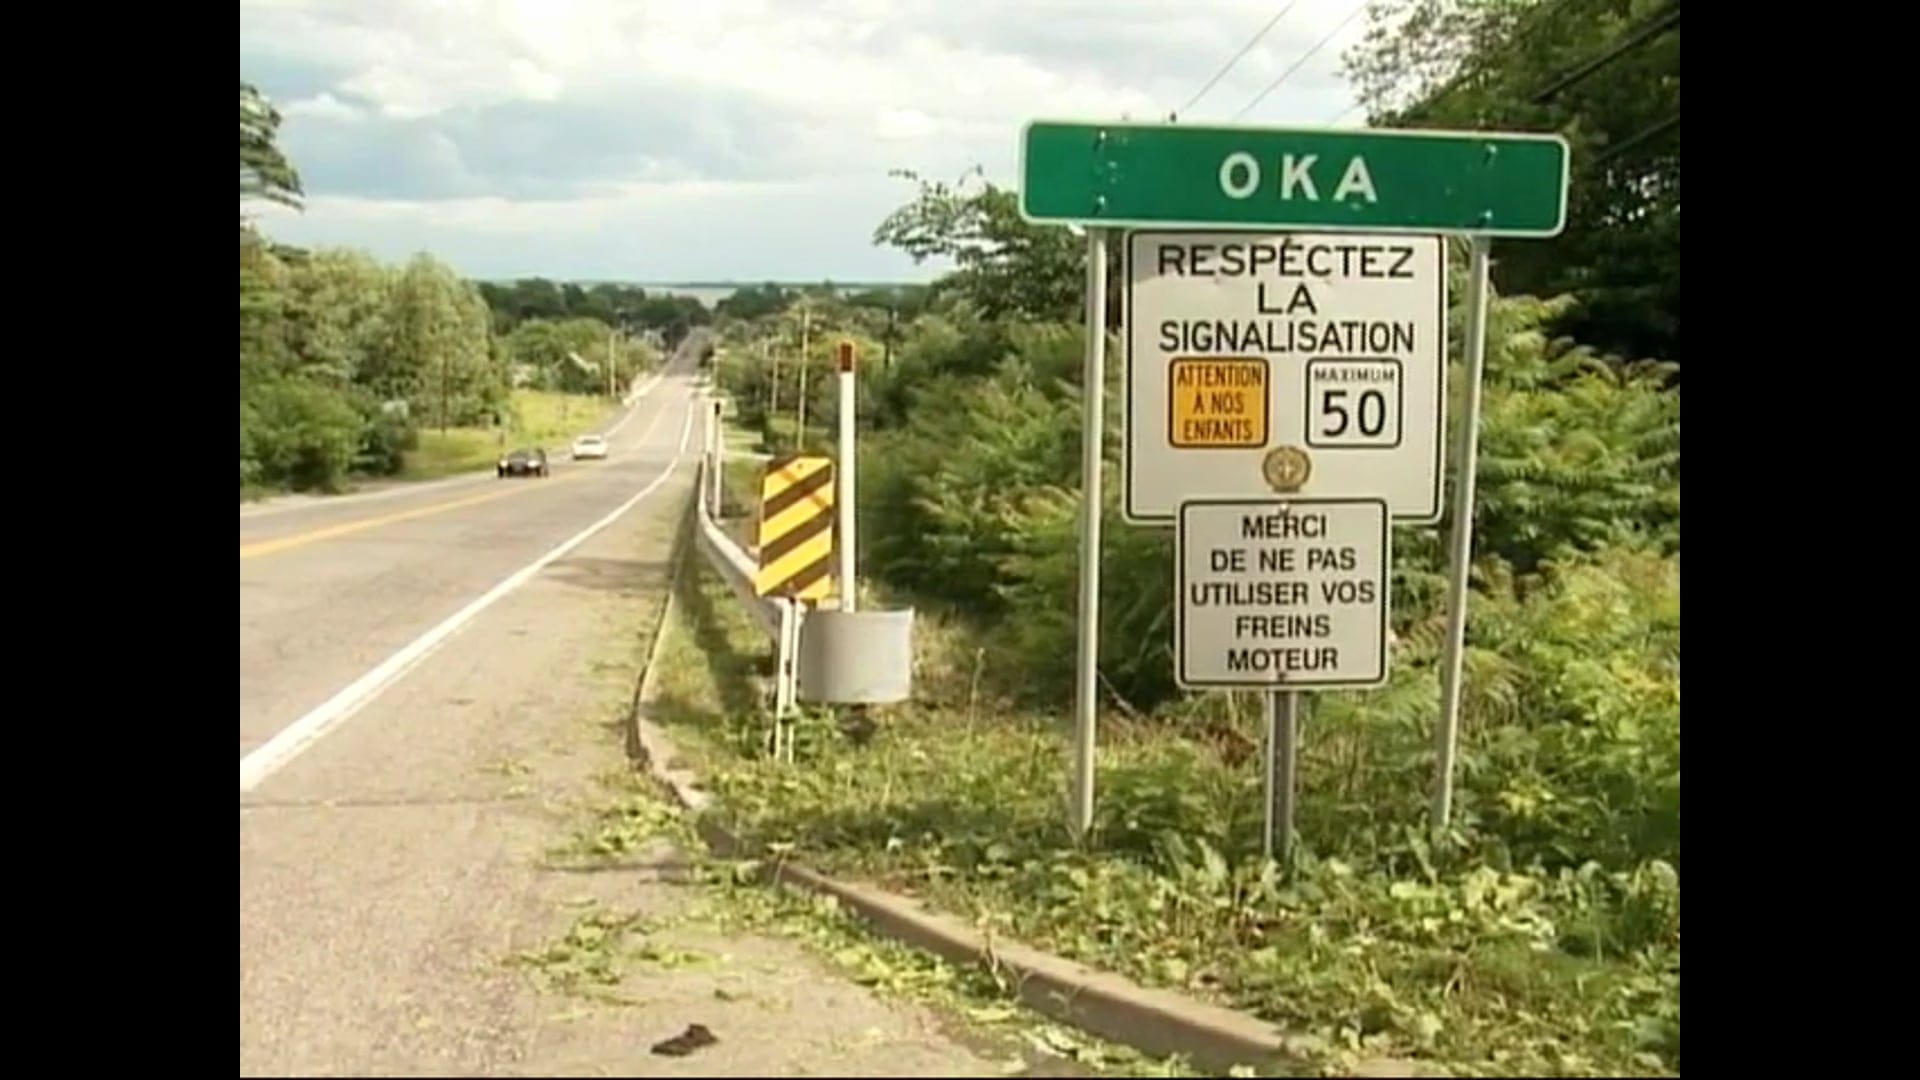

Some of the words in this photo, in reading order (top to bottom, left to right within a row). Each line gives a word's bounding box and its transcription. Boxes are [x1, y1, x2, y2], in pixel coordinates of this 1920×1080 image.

[1219, 151, 1378, 203] OKA
[1257, 282, 1317, 315] LA
[1158, 320, 1414, 353] SIGNALISATION
[1177, 364, 1262, 387] ATTENTION
[1314, 367, 1395, 382] MAXIMUM
[1211, 391, 1245, 415] NOS
[1322, 390, 1386, 437] 50
[1183, 419, 1253, 441] ENFANTS
[1242, 514, 1326, 539] MERCI
[1211, 549, 1246, 572] DE
[1259, 549, 1295, 572] NE
[1307, 547, 1356, 571] PAS
[1191, 582, 1309, 606] UTILISER
[1322, 580, 1375, 604] VOS
[1235, 615, 1331, 639] FREINS
[1227, 648, 1339, 671] MOTEUR
